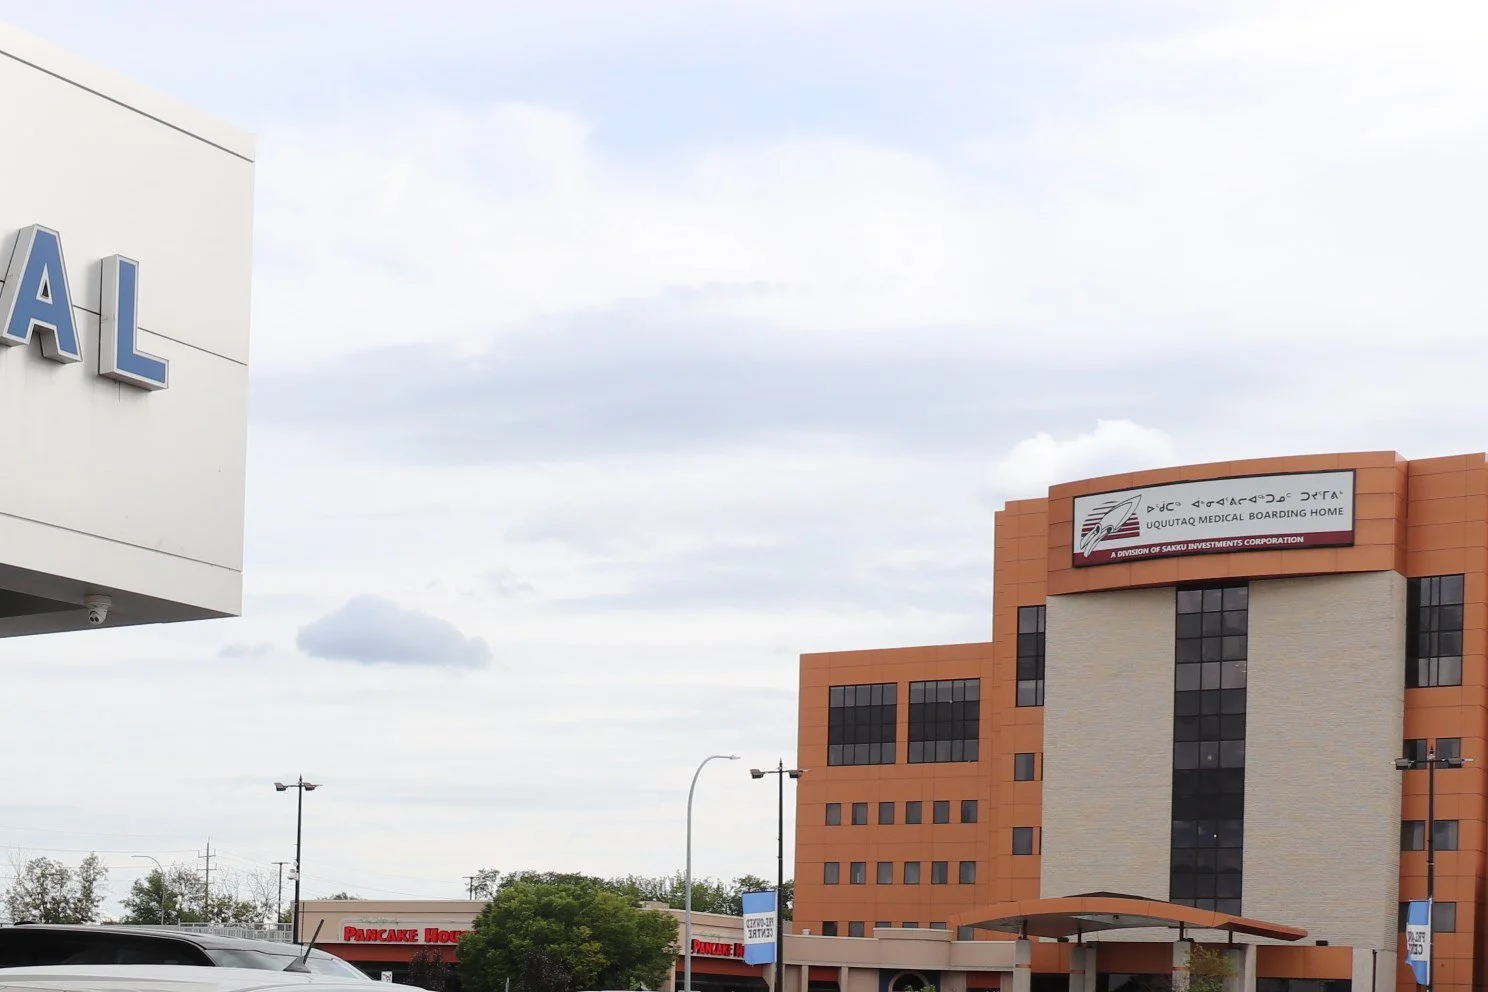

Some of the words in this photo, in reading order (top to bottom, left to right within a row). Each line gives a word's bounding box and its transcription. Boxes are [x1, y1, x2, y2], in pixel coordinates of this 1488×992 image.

[1146, 516, 1196, 530] UQUUTAQ
[1198, 513, 1244, 524] MEDICAL
[1249, 508, 1307, 520] BOARDING
[1310, 507, 1344, 517] HOME
[1117, 548, 1149, 557] DIVISION
[1150, 546, 1161, 554] OF
[1161, 543, 1187, 553] SAKKU
[1188, 539, 1243, 550] INVESTMENTS
[1244, 536, 1305, 546] CORPORATION
